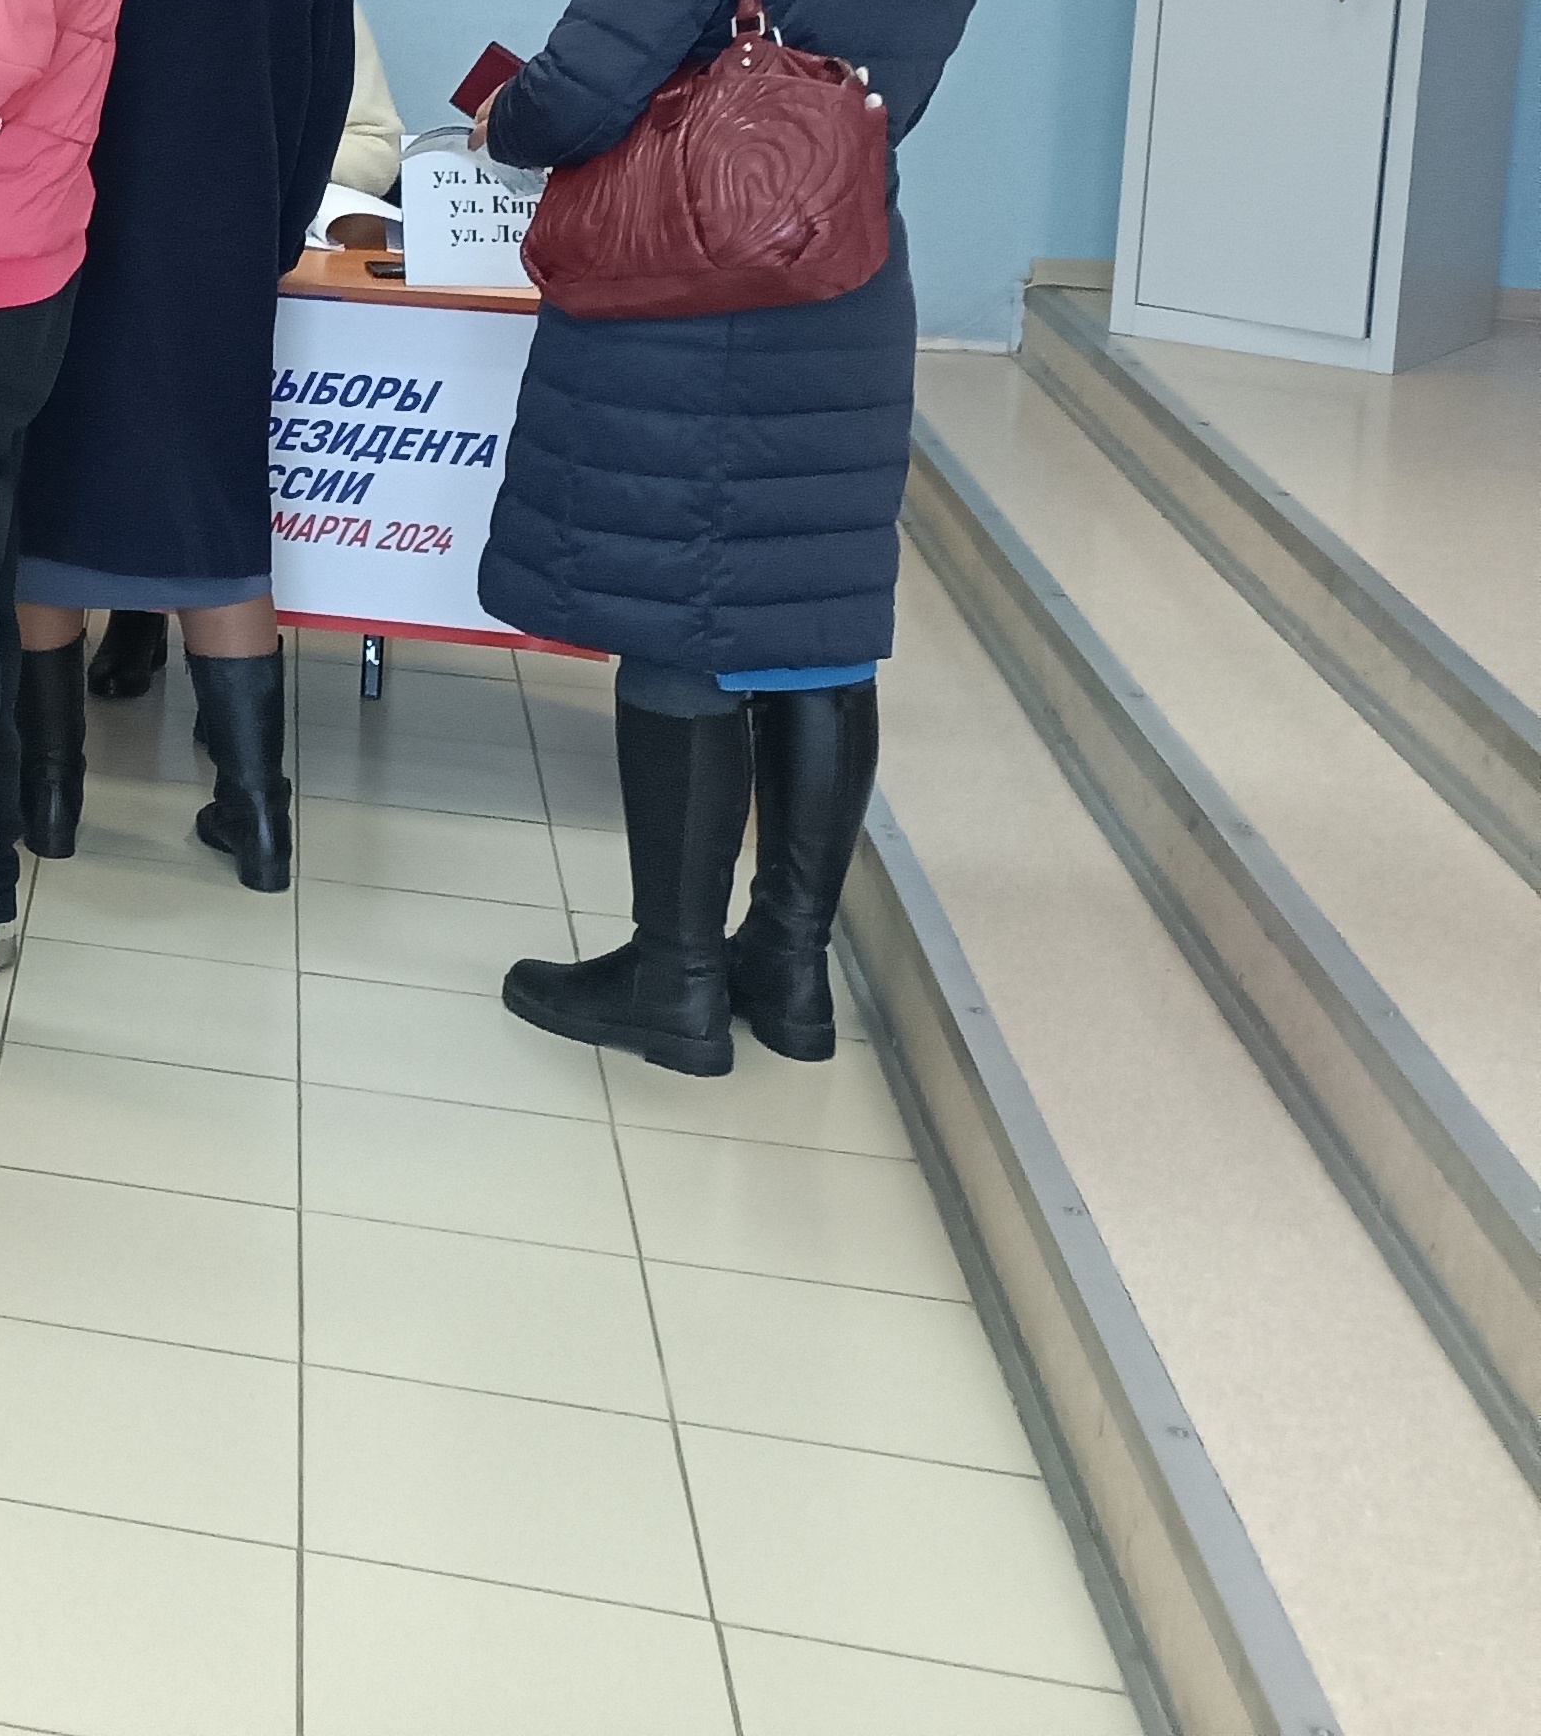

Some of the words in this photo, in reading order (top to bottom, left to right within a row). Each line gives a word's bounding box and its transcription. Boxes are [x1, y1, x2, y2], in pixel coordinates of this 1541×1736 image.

[432, 169, 467, 189] ул.
[449, 199, 484, 218] ул.
[492, 195, 538, 219] Кир
[450, 228, 485, 247] ул.
[270, 369, 443, 414] ЫБОРЫ
[271, 510, 372, 548] МАРТА
[375, 521, 454, 555] 2024
